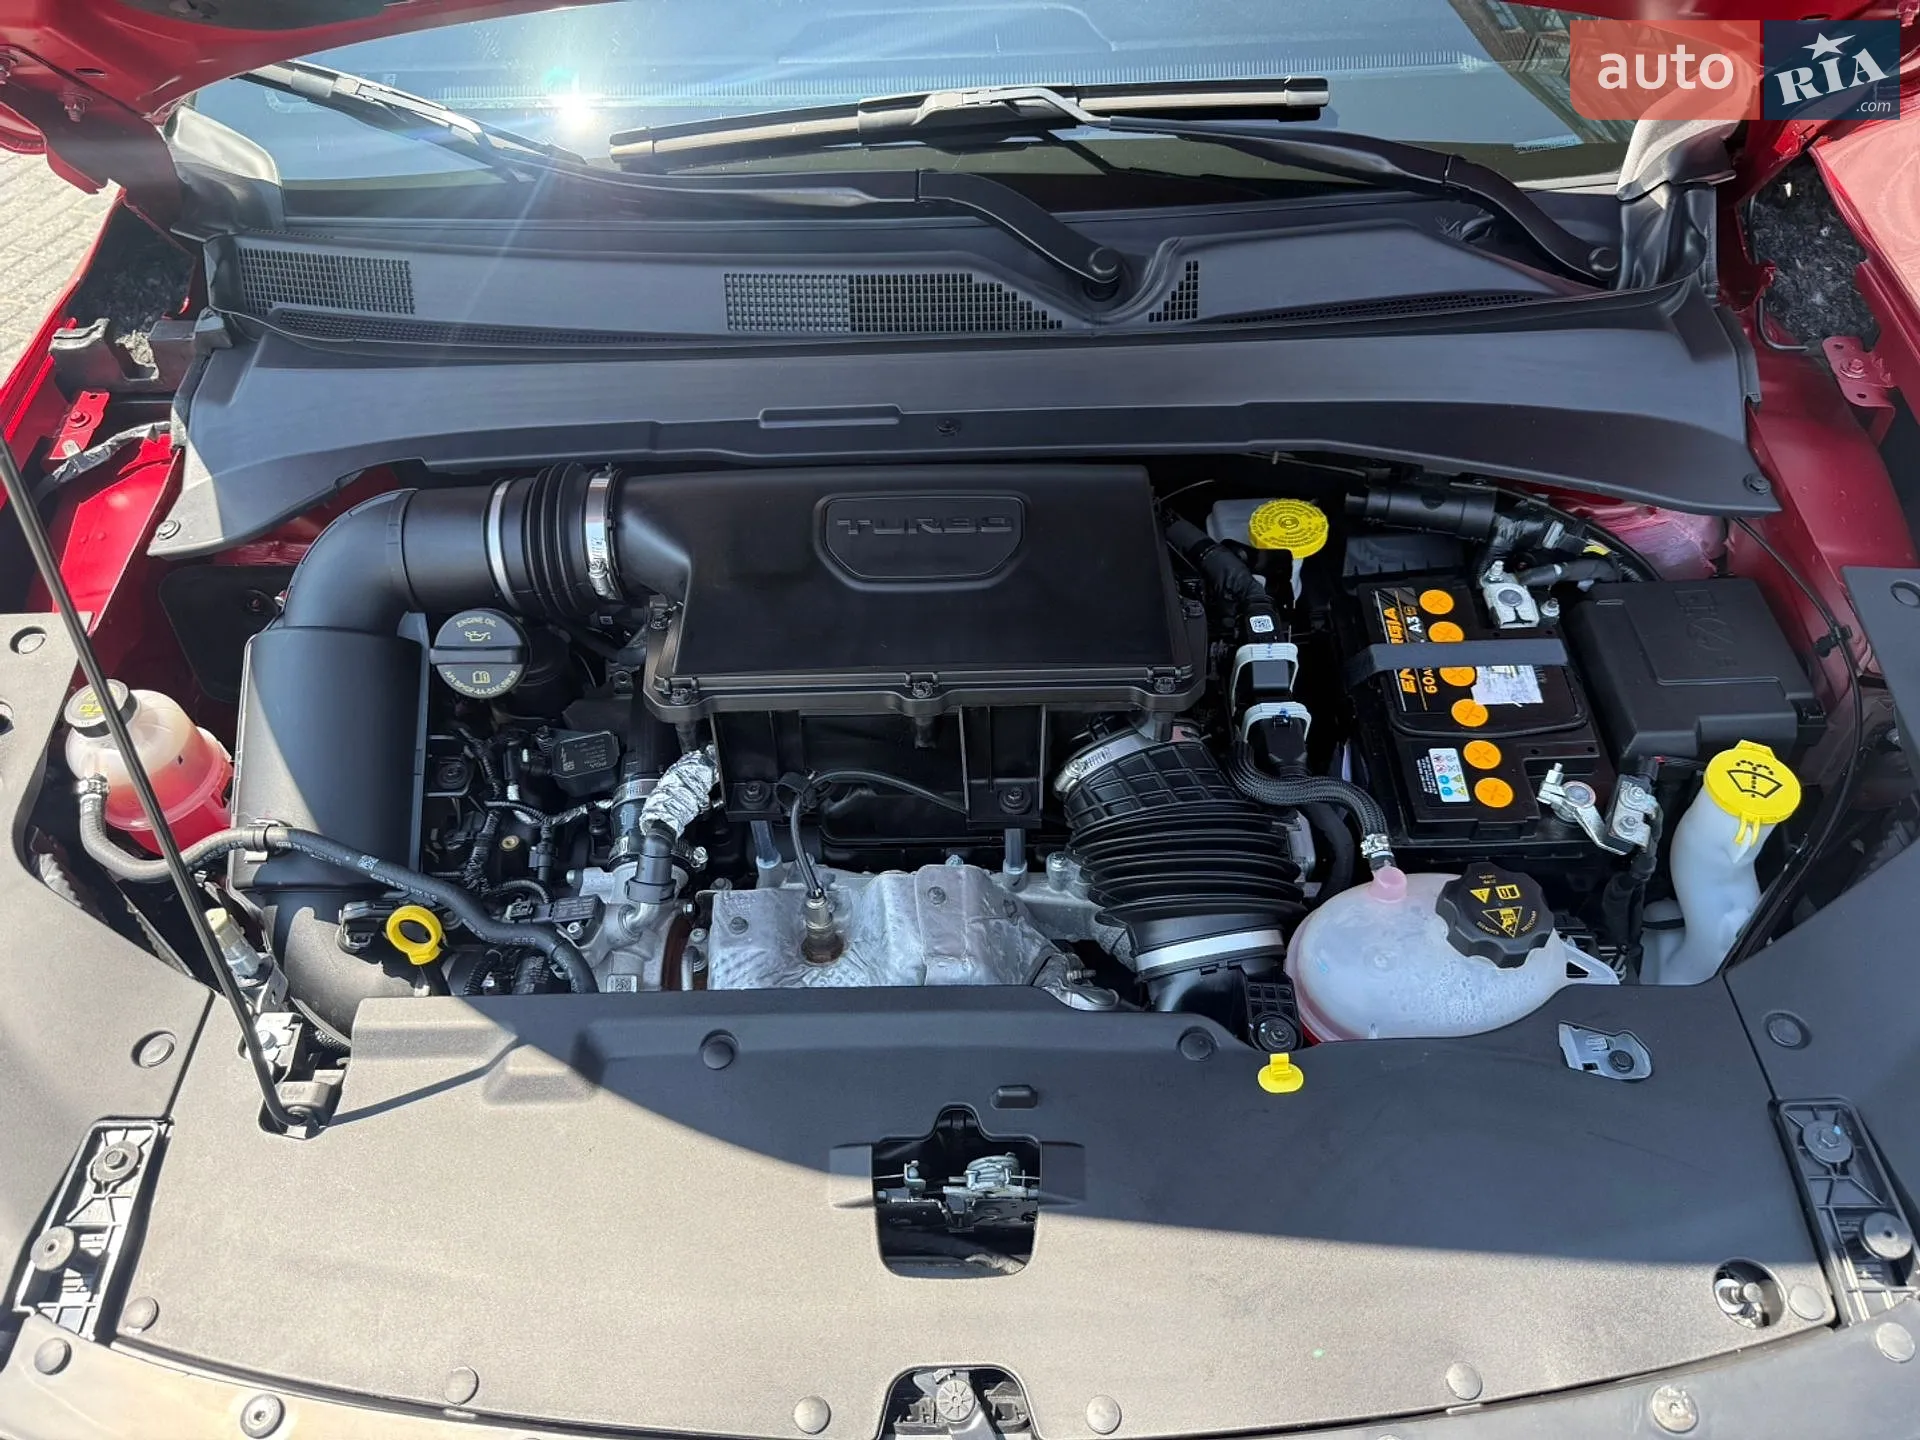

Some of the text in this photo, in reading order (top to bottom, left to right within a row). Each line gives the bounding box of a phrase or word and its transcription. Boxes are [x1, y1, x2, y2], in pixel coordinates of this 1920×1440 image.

[836, 517, 1012, 535] TURBO
[456, 616, 497, 628] ENGINE OIL
